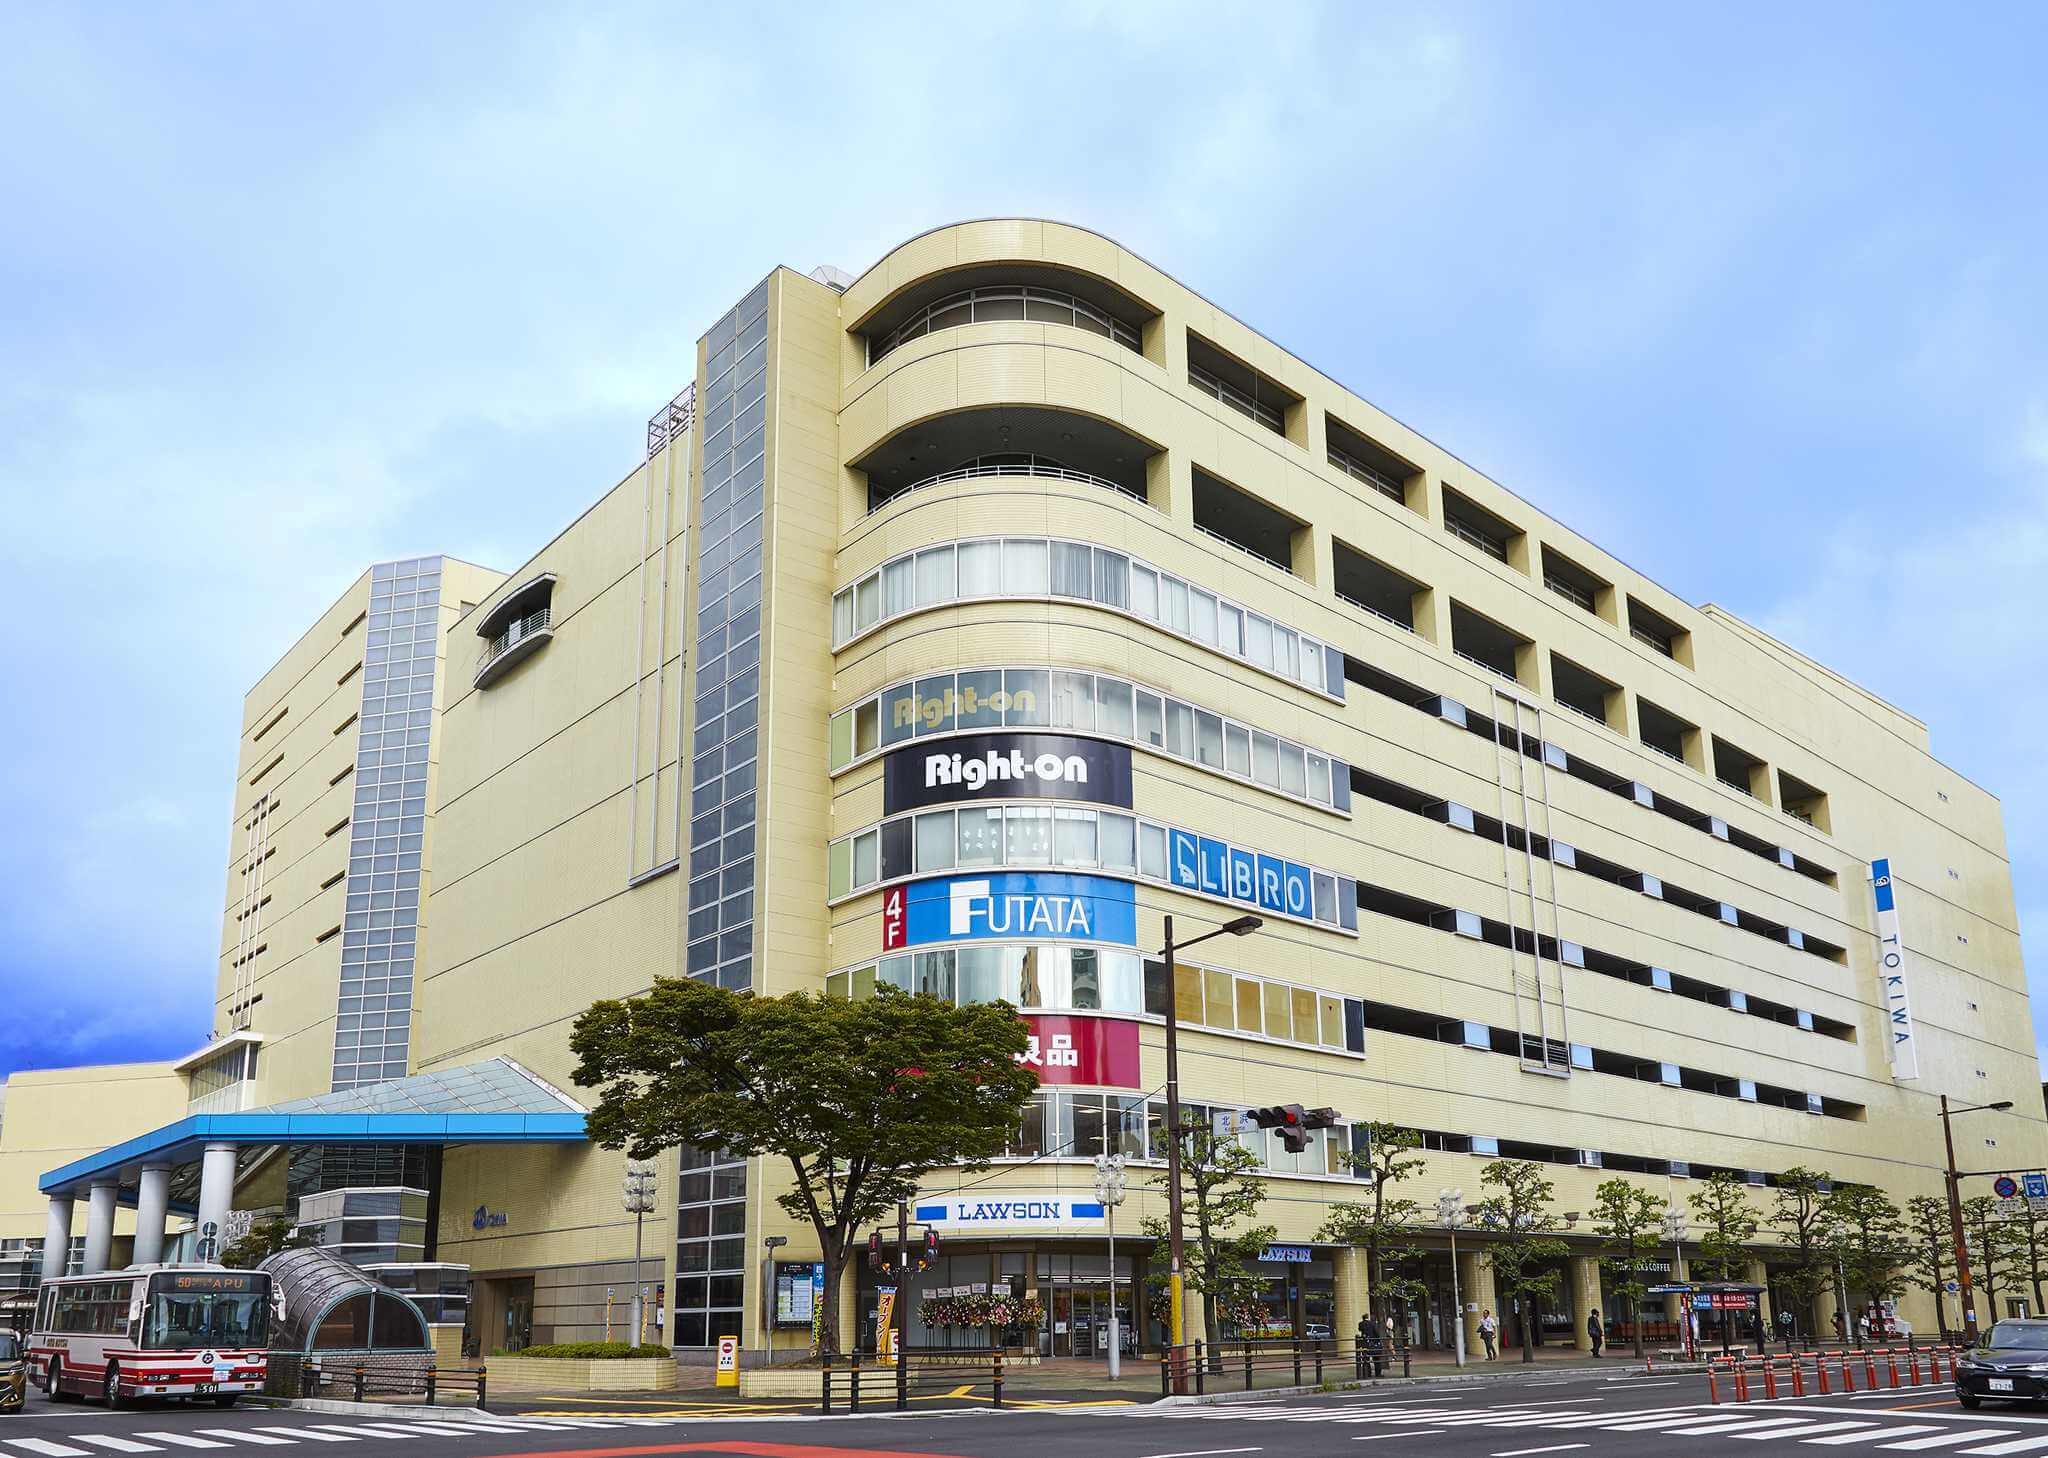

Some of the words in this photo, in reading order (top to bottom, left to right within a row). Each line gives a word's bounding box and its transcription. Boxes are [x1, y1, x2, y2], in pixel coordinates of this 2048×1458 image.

[893, 687, 1037, 729] Right-on
[925, 749, 1088, 791] Right-on
[1201, 850, 1306, 913] LIBRO
[949, 879, 1091, 936] FUTATA
[1882, 933, 1911, 1044] TOKIWA
[958, 1202, 1061, 1220] LAWSON
[1257, 1246, 1312, 1263] LAWSON
[1648, 1263, 1671, 1272] COFFEE
[177, 1277, 192, 1288] 50
[212, 1279, 243, 1288] APU
